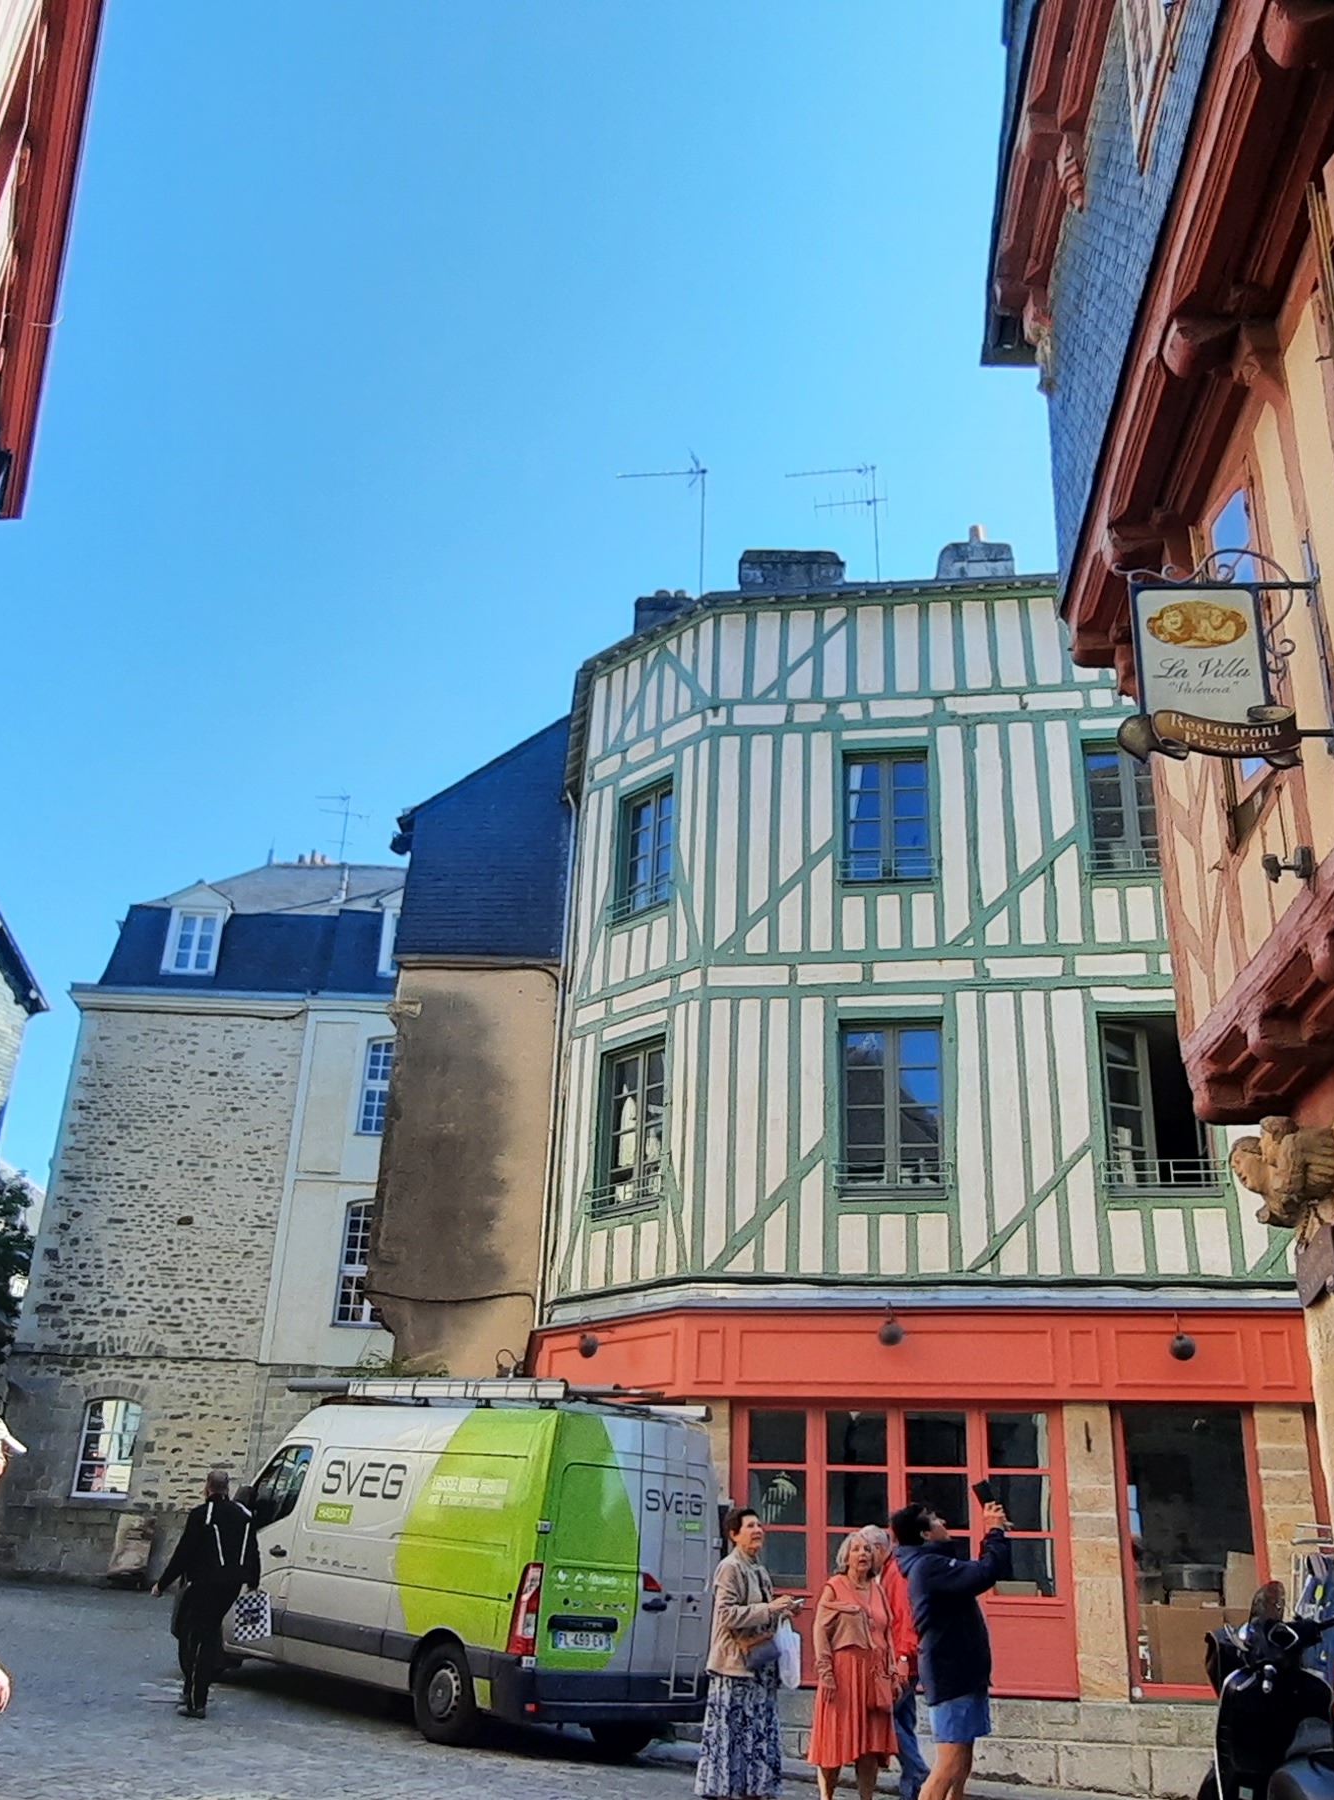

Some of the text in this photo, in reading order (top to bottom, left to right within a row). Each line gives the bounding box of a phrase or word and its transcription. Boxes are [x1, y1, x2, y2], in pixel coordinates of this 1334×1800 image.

[1152, 657, 1251, 679] La Villa
[1170, 713, 1282, 738] Restaurant
[1184, 731, 1272, 752] Pizzéria
[321, 1459, 408, 1500] SVEG
[645, 1488, 703, 1517] SVEG
